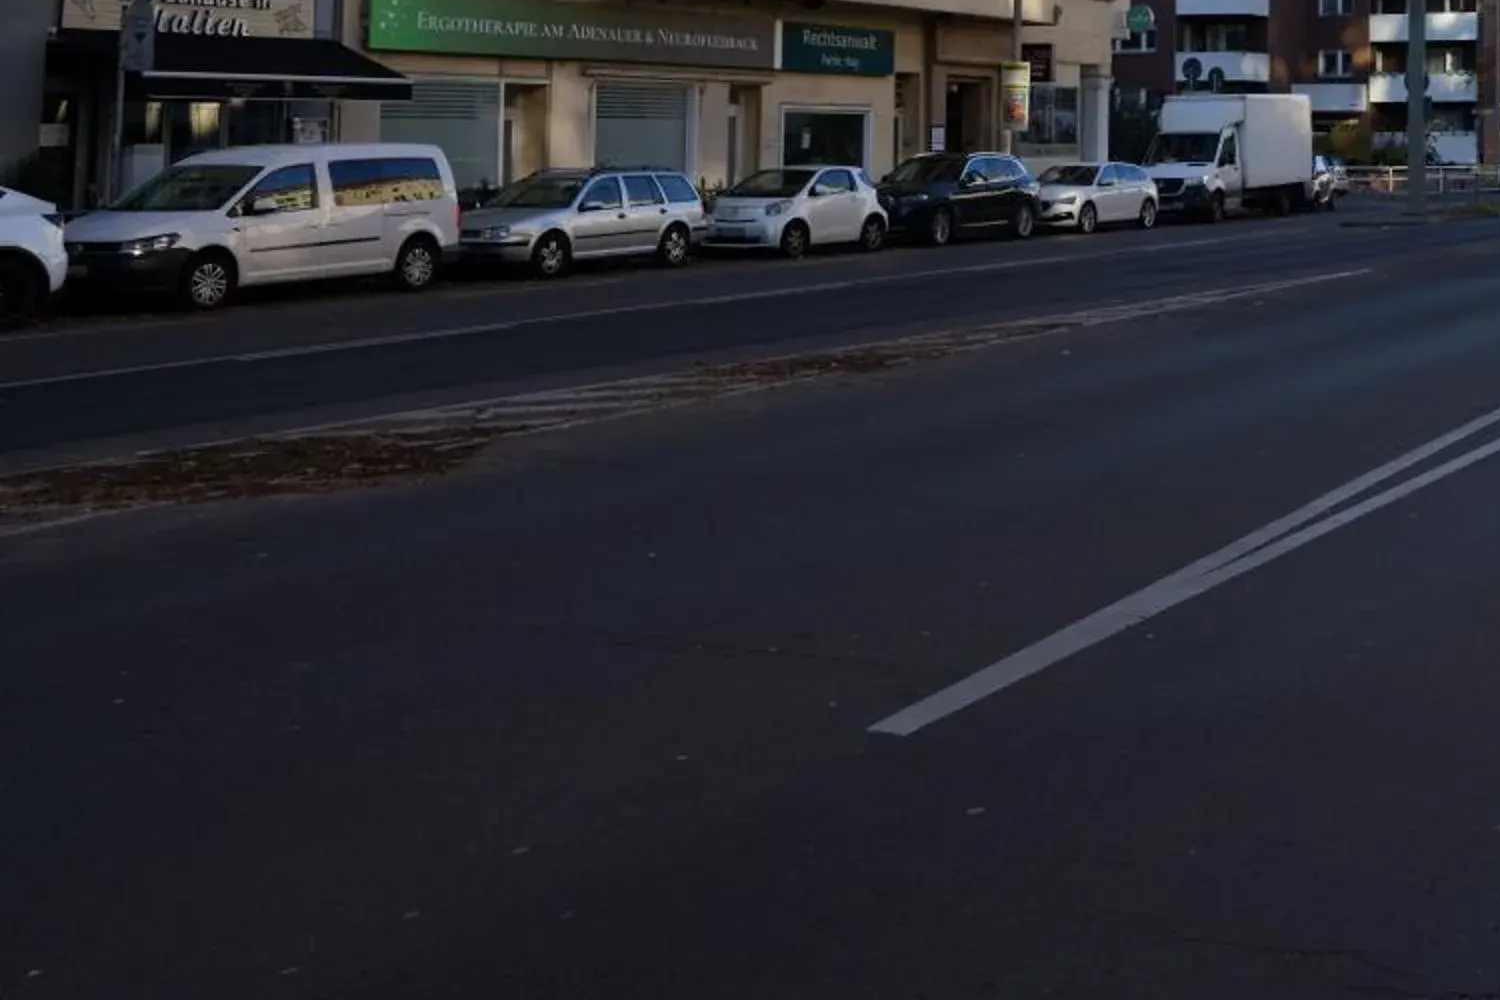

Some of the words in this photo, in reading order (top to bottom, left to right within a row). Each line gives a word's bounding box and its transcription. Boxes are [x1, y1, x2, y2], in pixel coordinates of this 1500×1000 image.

[140, 6, 250, 38] talien
[416, 10, 538, 38] ERGOTHERAPIE
[540, 23, 564, 39] AM
[565, 23, 645, 43] ADENAUER
[802, 28, 881, 52] Rechtsanwalt
